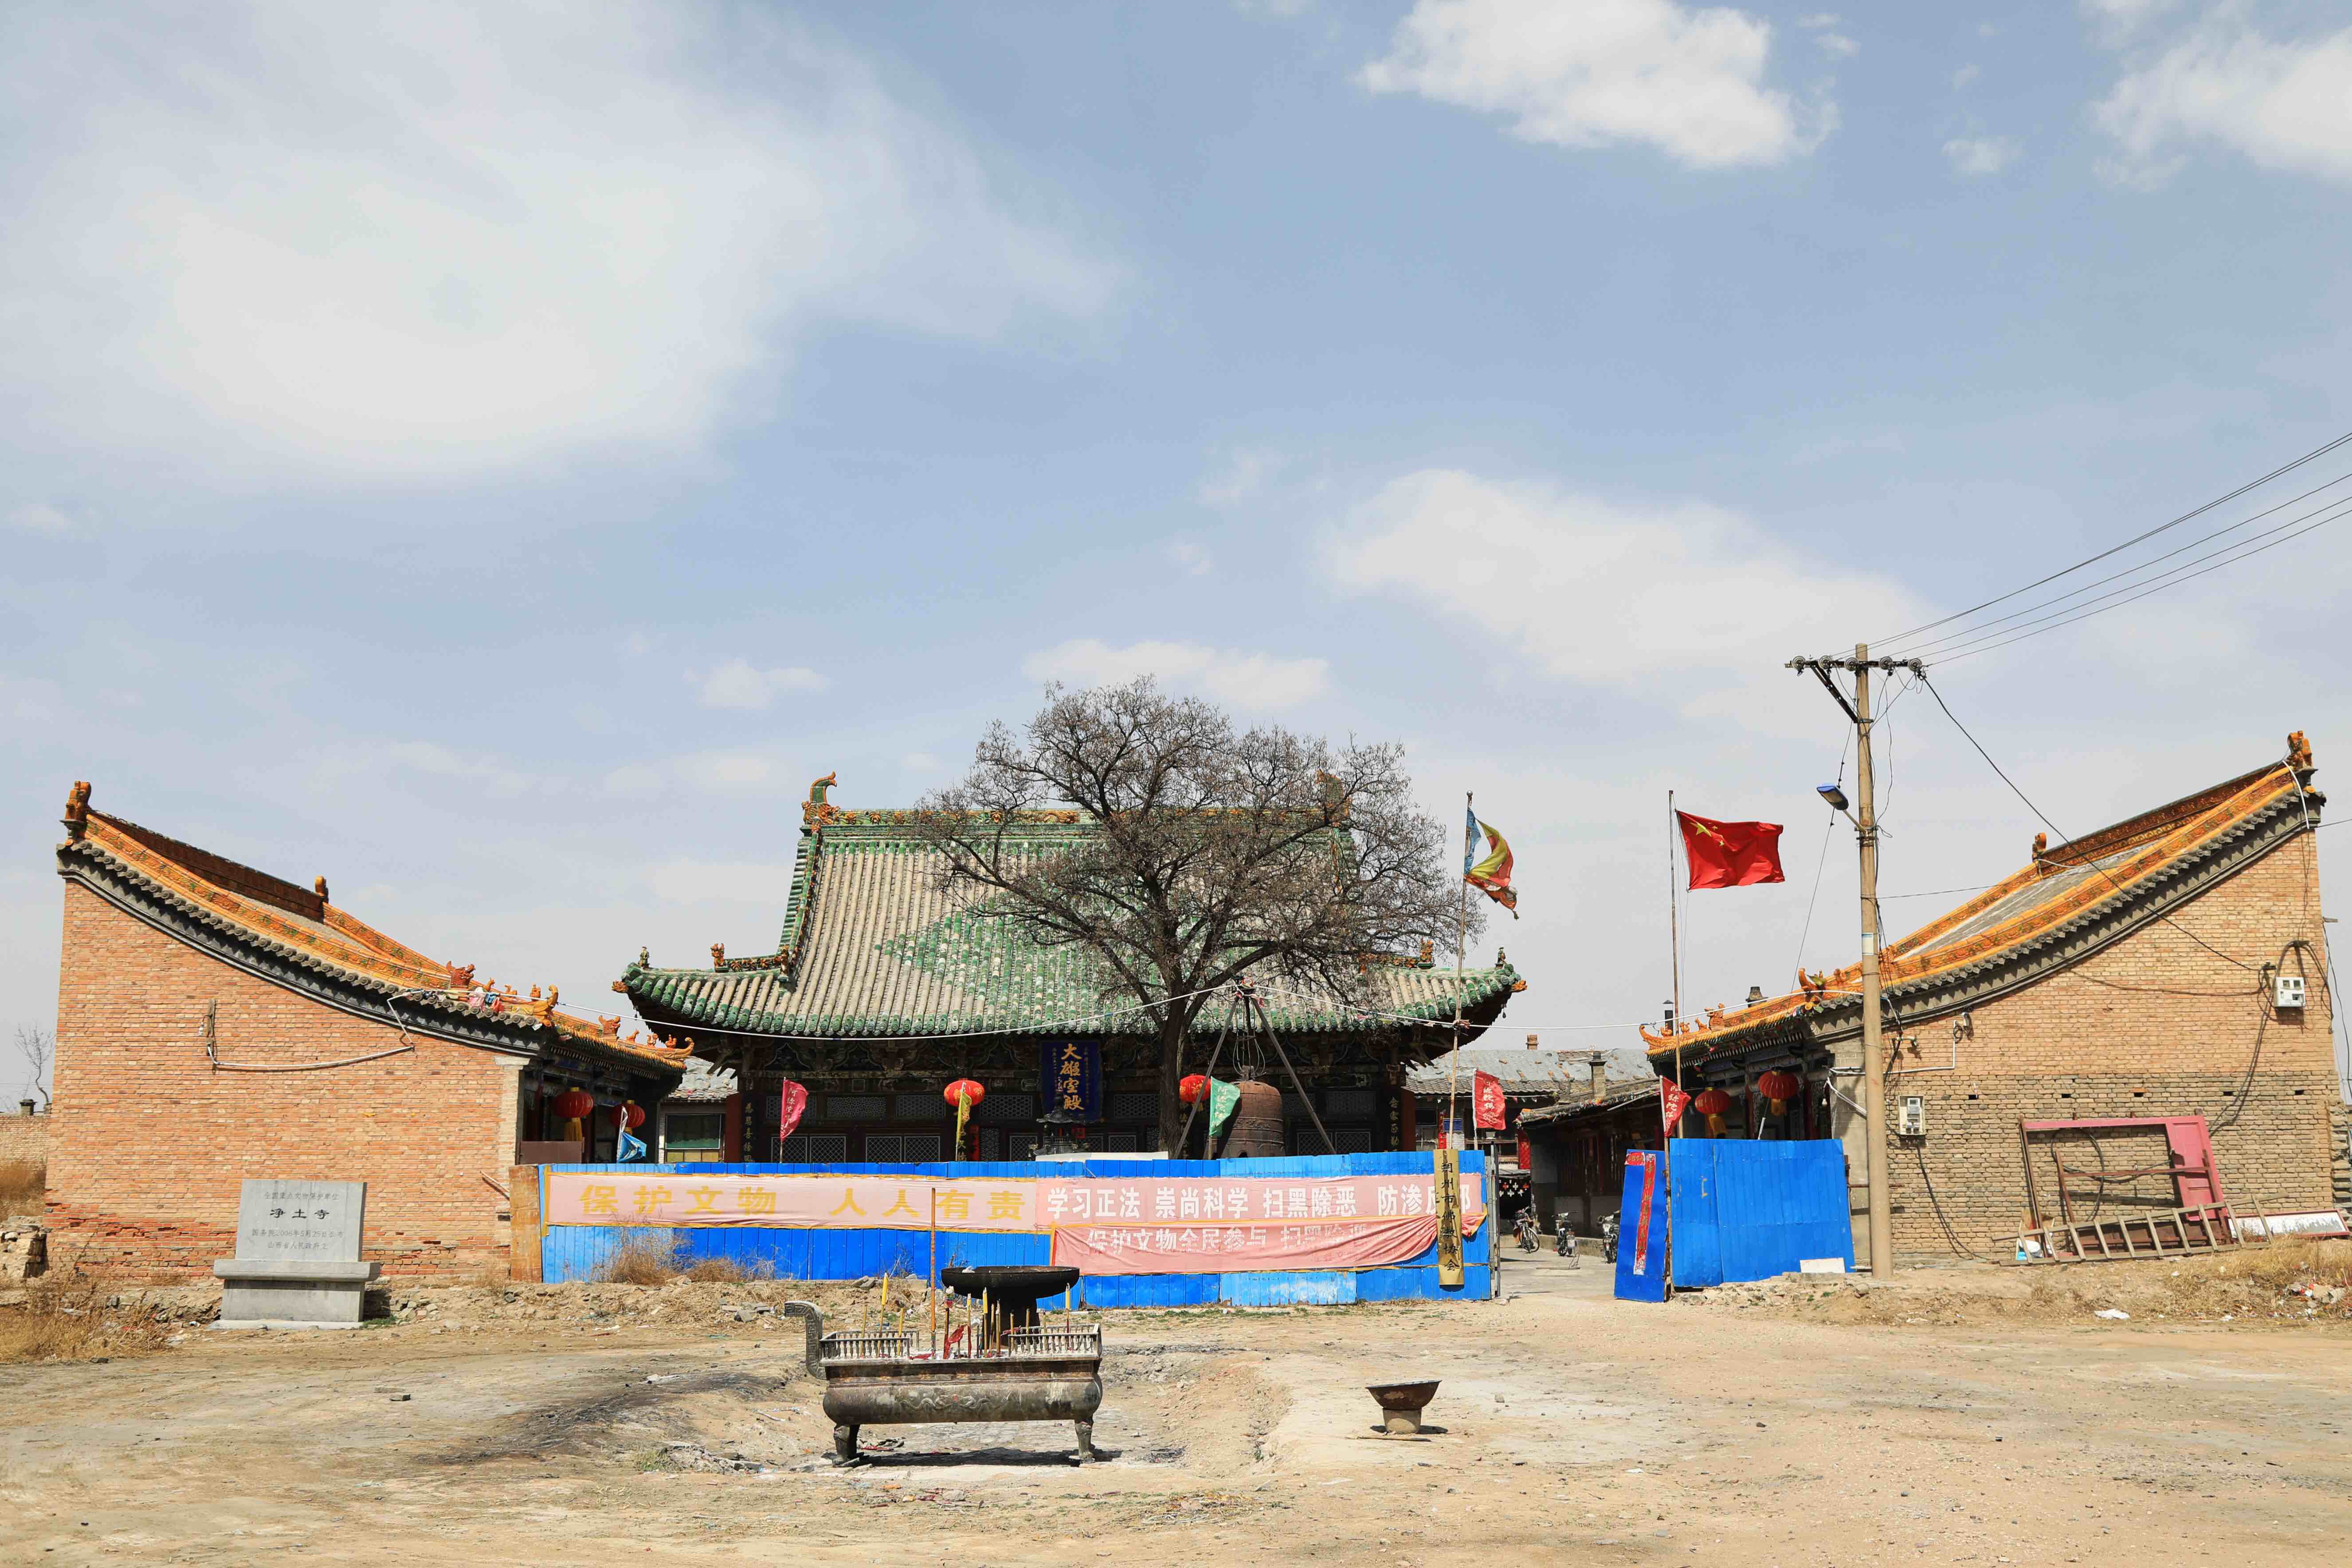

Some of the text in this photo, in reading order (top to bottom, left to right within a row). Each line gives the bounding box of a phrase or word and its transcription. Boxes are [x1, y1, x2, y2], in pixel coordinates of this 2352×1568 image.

[270, 1208, 330, 1219] 净土寺
[578, 1184, 1025, 1220] 保护文物 人人有责
[1047, 1187, 1141, 1219] 学习正法
[1156, 1187, 1249, 1219] 崇尚科学
[1263, 1185, 1356, 1219] 扫黑除恶
[1087, 1226, 1266, 1254] 保护文物全民参与
